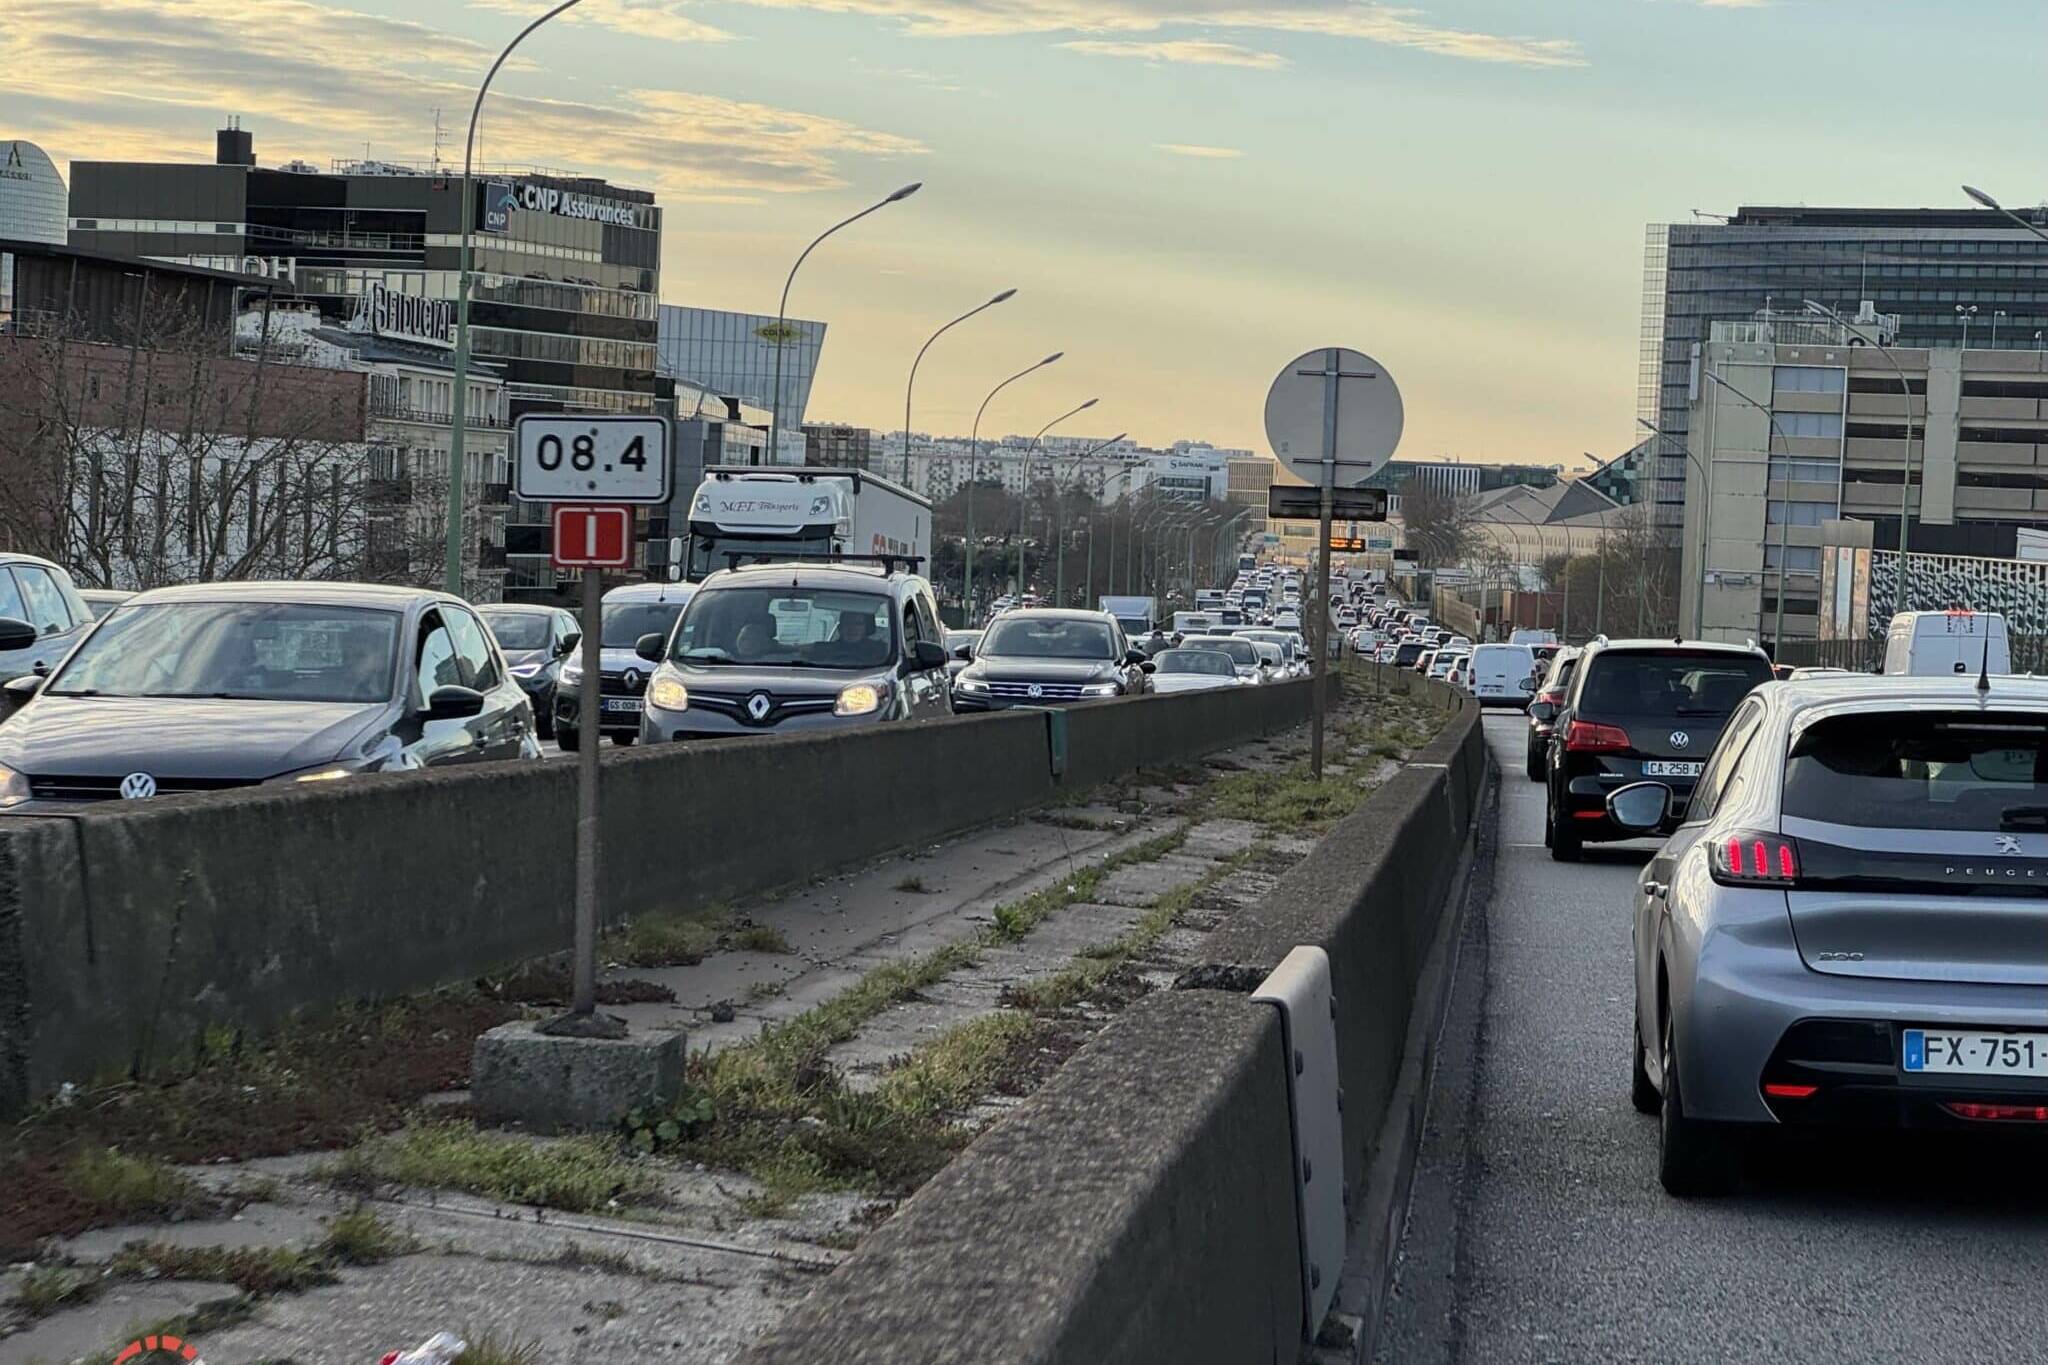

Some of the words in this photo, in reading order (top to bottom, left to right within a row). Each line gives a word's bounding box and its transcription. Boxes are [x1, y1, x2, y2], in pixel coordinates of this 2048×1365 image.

[524, 184, 559, 212] CNP
[559, 192, 634, 226] Assurances
[487, 212, 506, 225] CNP
[537, 434, 647, 473] 08.4
[1945, 867, 2048, 877] PEUGE
